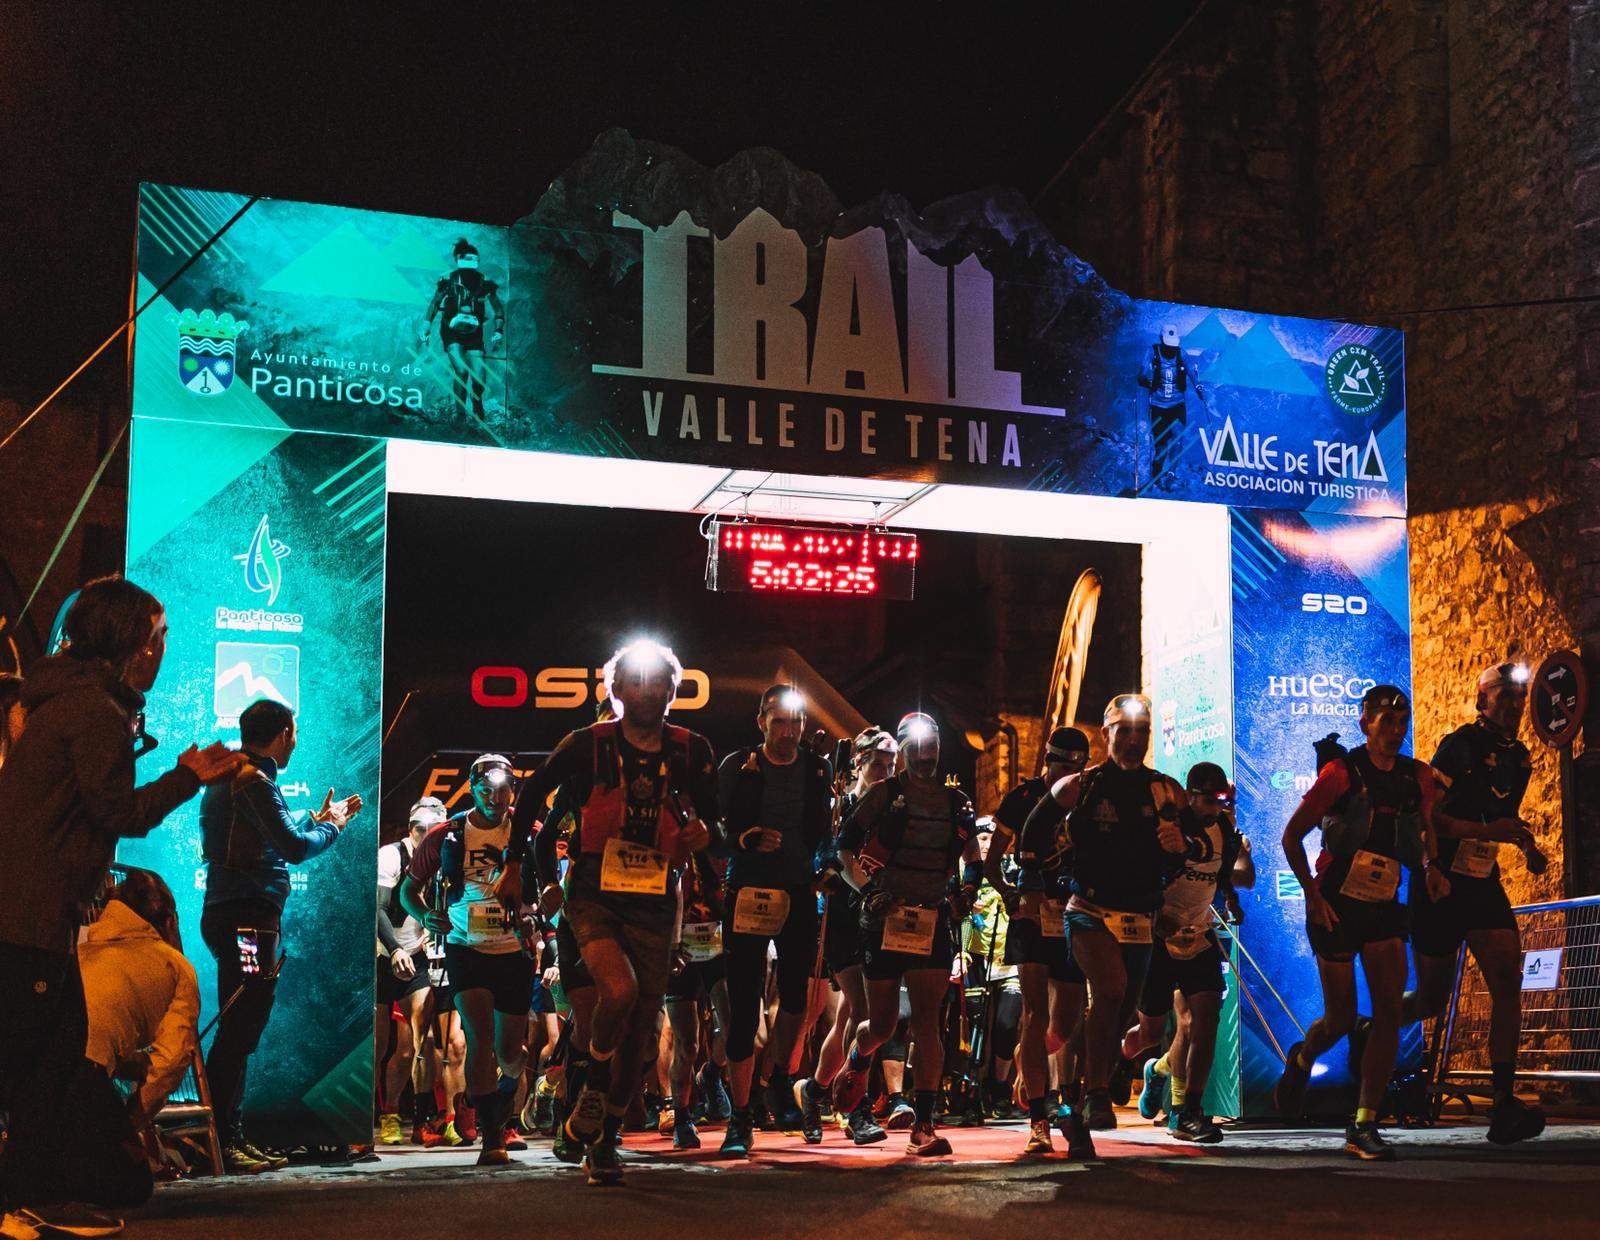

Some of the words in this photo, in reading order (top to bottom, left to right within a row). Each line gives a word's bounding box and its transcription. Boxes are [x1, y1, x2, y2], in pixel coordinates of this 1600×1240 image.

[605, 206, 1028, 404] TRAIL
[250, 348, 392, 375] Ayuntamiento
[400, 361, 423, 376] de
[250, 367, 424, 409] Panticosa
[642, 390, 796, 449] VALLE
[824, 407, 877, 455] DE
[904, 414, 1022, 468] TENA
[1199, 414, 1279, 472] VALLE
[1284, 452, 1309, 475] DE
[1313, 430, 1389, 483] TENA
[1204, 471, 1304, 495] ASOCIACION
[1308, 481, 1390, 501] TURISTICA
